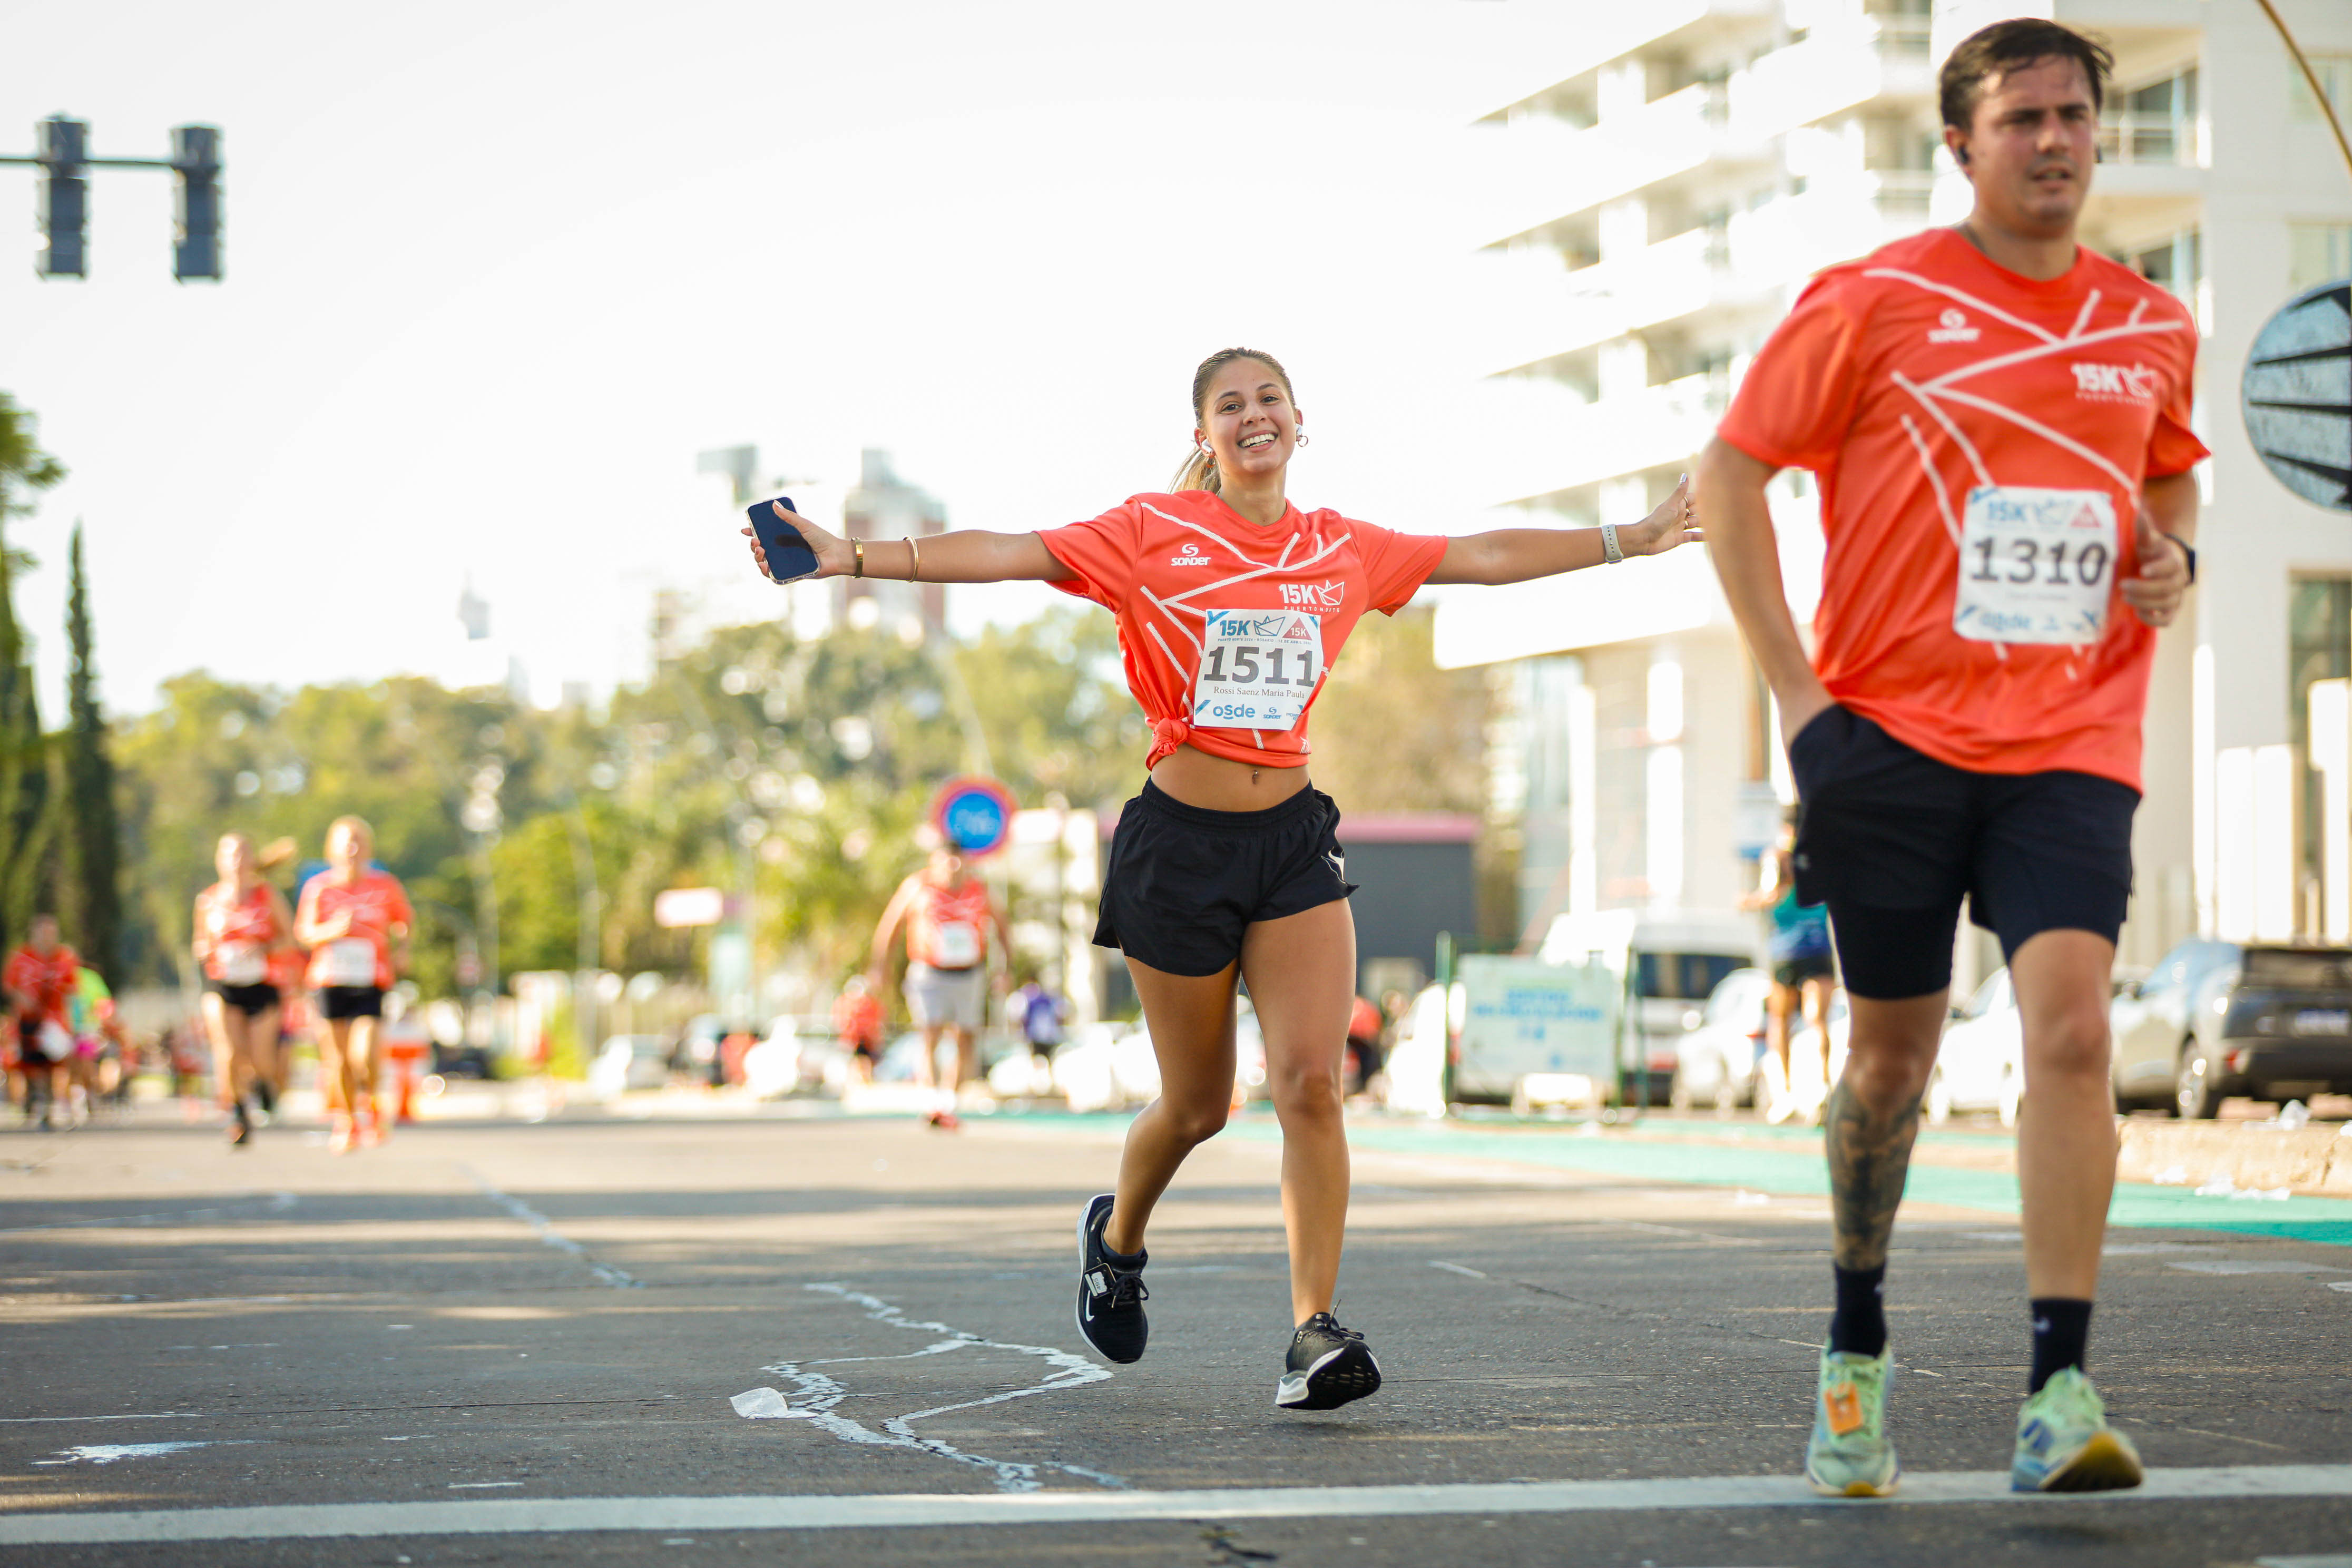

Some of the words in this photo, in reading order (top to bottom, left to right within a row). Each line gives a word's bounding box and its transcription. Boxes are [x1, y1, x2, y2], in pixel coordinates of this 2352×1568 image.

[2071, 364, 2122, 394] 15K
[1971, 537, 2109, 585] 1310
[1279, 584, 1317, 604] 15K
[1220, 620, 1251, 636] 15K
[1290, 627, 1307, 636] 15K
[1203, 646, 1315, 688] 1511
[1213, 686, 1234, 694] Rossi
[1237, 687, 1259, 695] Saenz
[1287, 690, 1305, 698] Paula
[1213, 704, 1256, 719] osde
